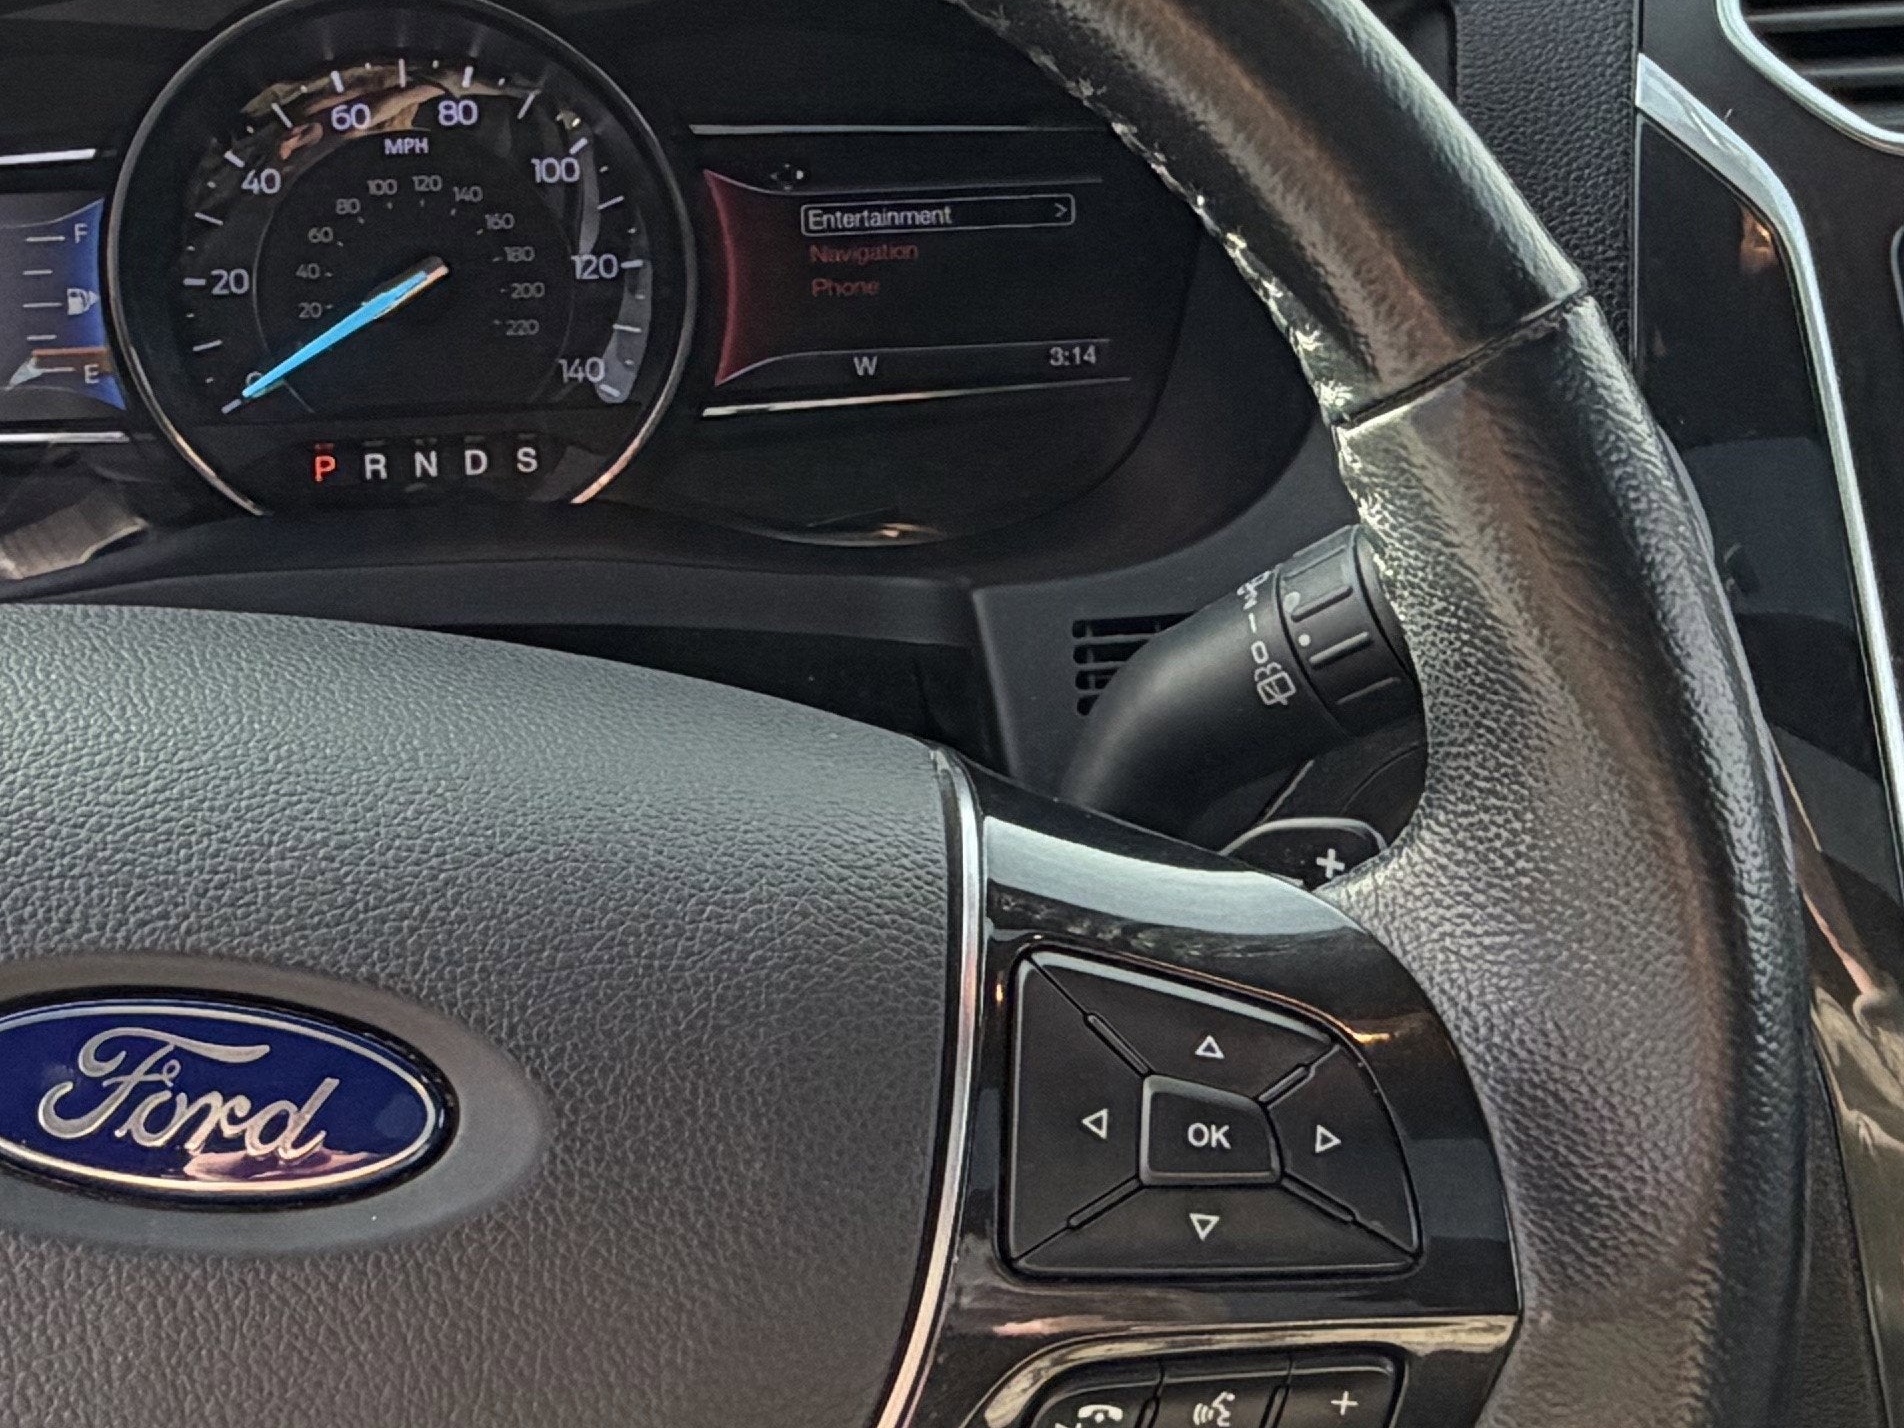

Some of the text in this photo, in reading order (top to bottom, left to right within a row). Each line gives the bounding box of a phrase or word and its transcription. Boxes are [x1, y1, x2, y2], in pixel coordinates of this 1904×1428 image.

[331, 104, 371, 129] 60
[438, 100, 479, 126] 80
[384, 138, 429, 155] MPH
[531, 157, 580, 182] 100
[242, 170, 281, 195] 40
[367, 179, 397, 195] 100
[412, 175, 442, 192] 120
[453, 187, 483, 202] 140
[336, 198, 360, 215] 80
[808, 206, 952, 230] Entertainment
[74, 224, 88, 243] F
[308, 227, 333, 244] 60
[505, 246, 535, 262] 180
[810, 243, 918, 265] Navigation
[296, 263, 320, 279] 40
[572, 253, 618, 280] 120
[210, 269, 250, 294] 20
[511, 282, 545, 298] 200
[812, 278, 880, 297] Phone
[298, 302, 323, 318] 20
[505, 319, 539, 336] 220
[1049, 346, 1097, 366] 3:14
[84, 365, 99, 384] E
[559, 357, 605, 383] 140
[854, 357, 878, 376] W
[315, 447, 538, 481] P R N D S
[38, 1026, 341, 1162] Ford
[1187, 1123, 1231, 1149] OK
